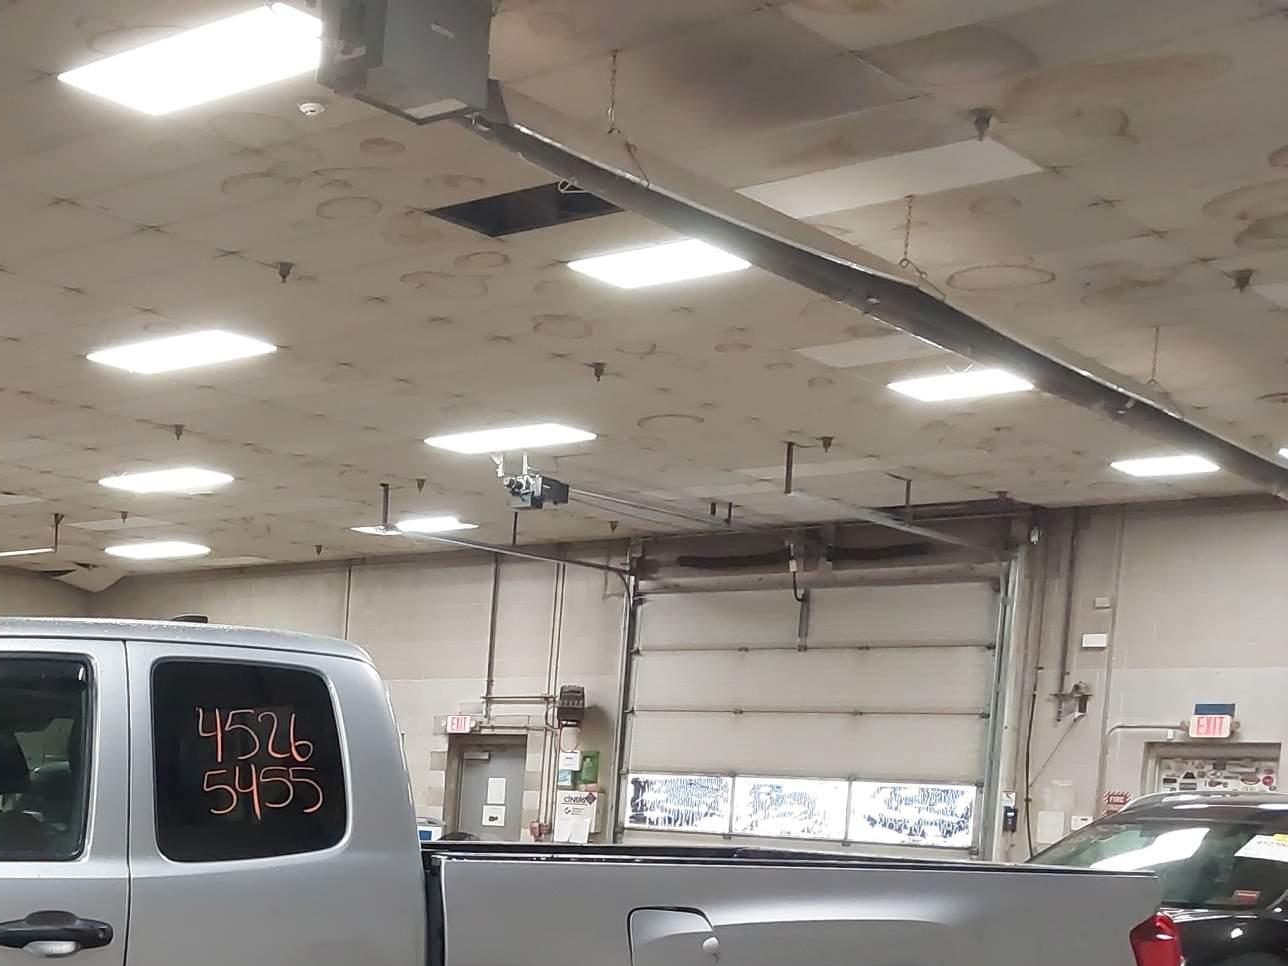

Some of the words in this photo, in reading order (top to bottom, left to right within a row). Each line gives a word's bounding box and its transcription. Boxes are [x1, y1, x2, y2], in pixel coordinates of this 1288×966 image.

[196, 707, 314, 763] 4526
[450, 716, 469, 731] EXIT
[1196, 716, 1225, 736] EXIT
[203, 764, 324, 820] 5455
